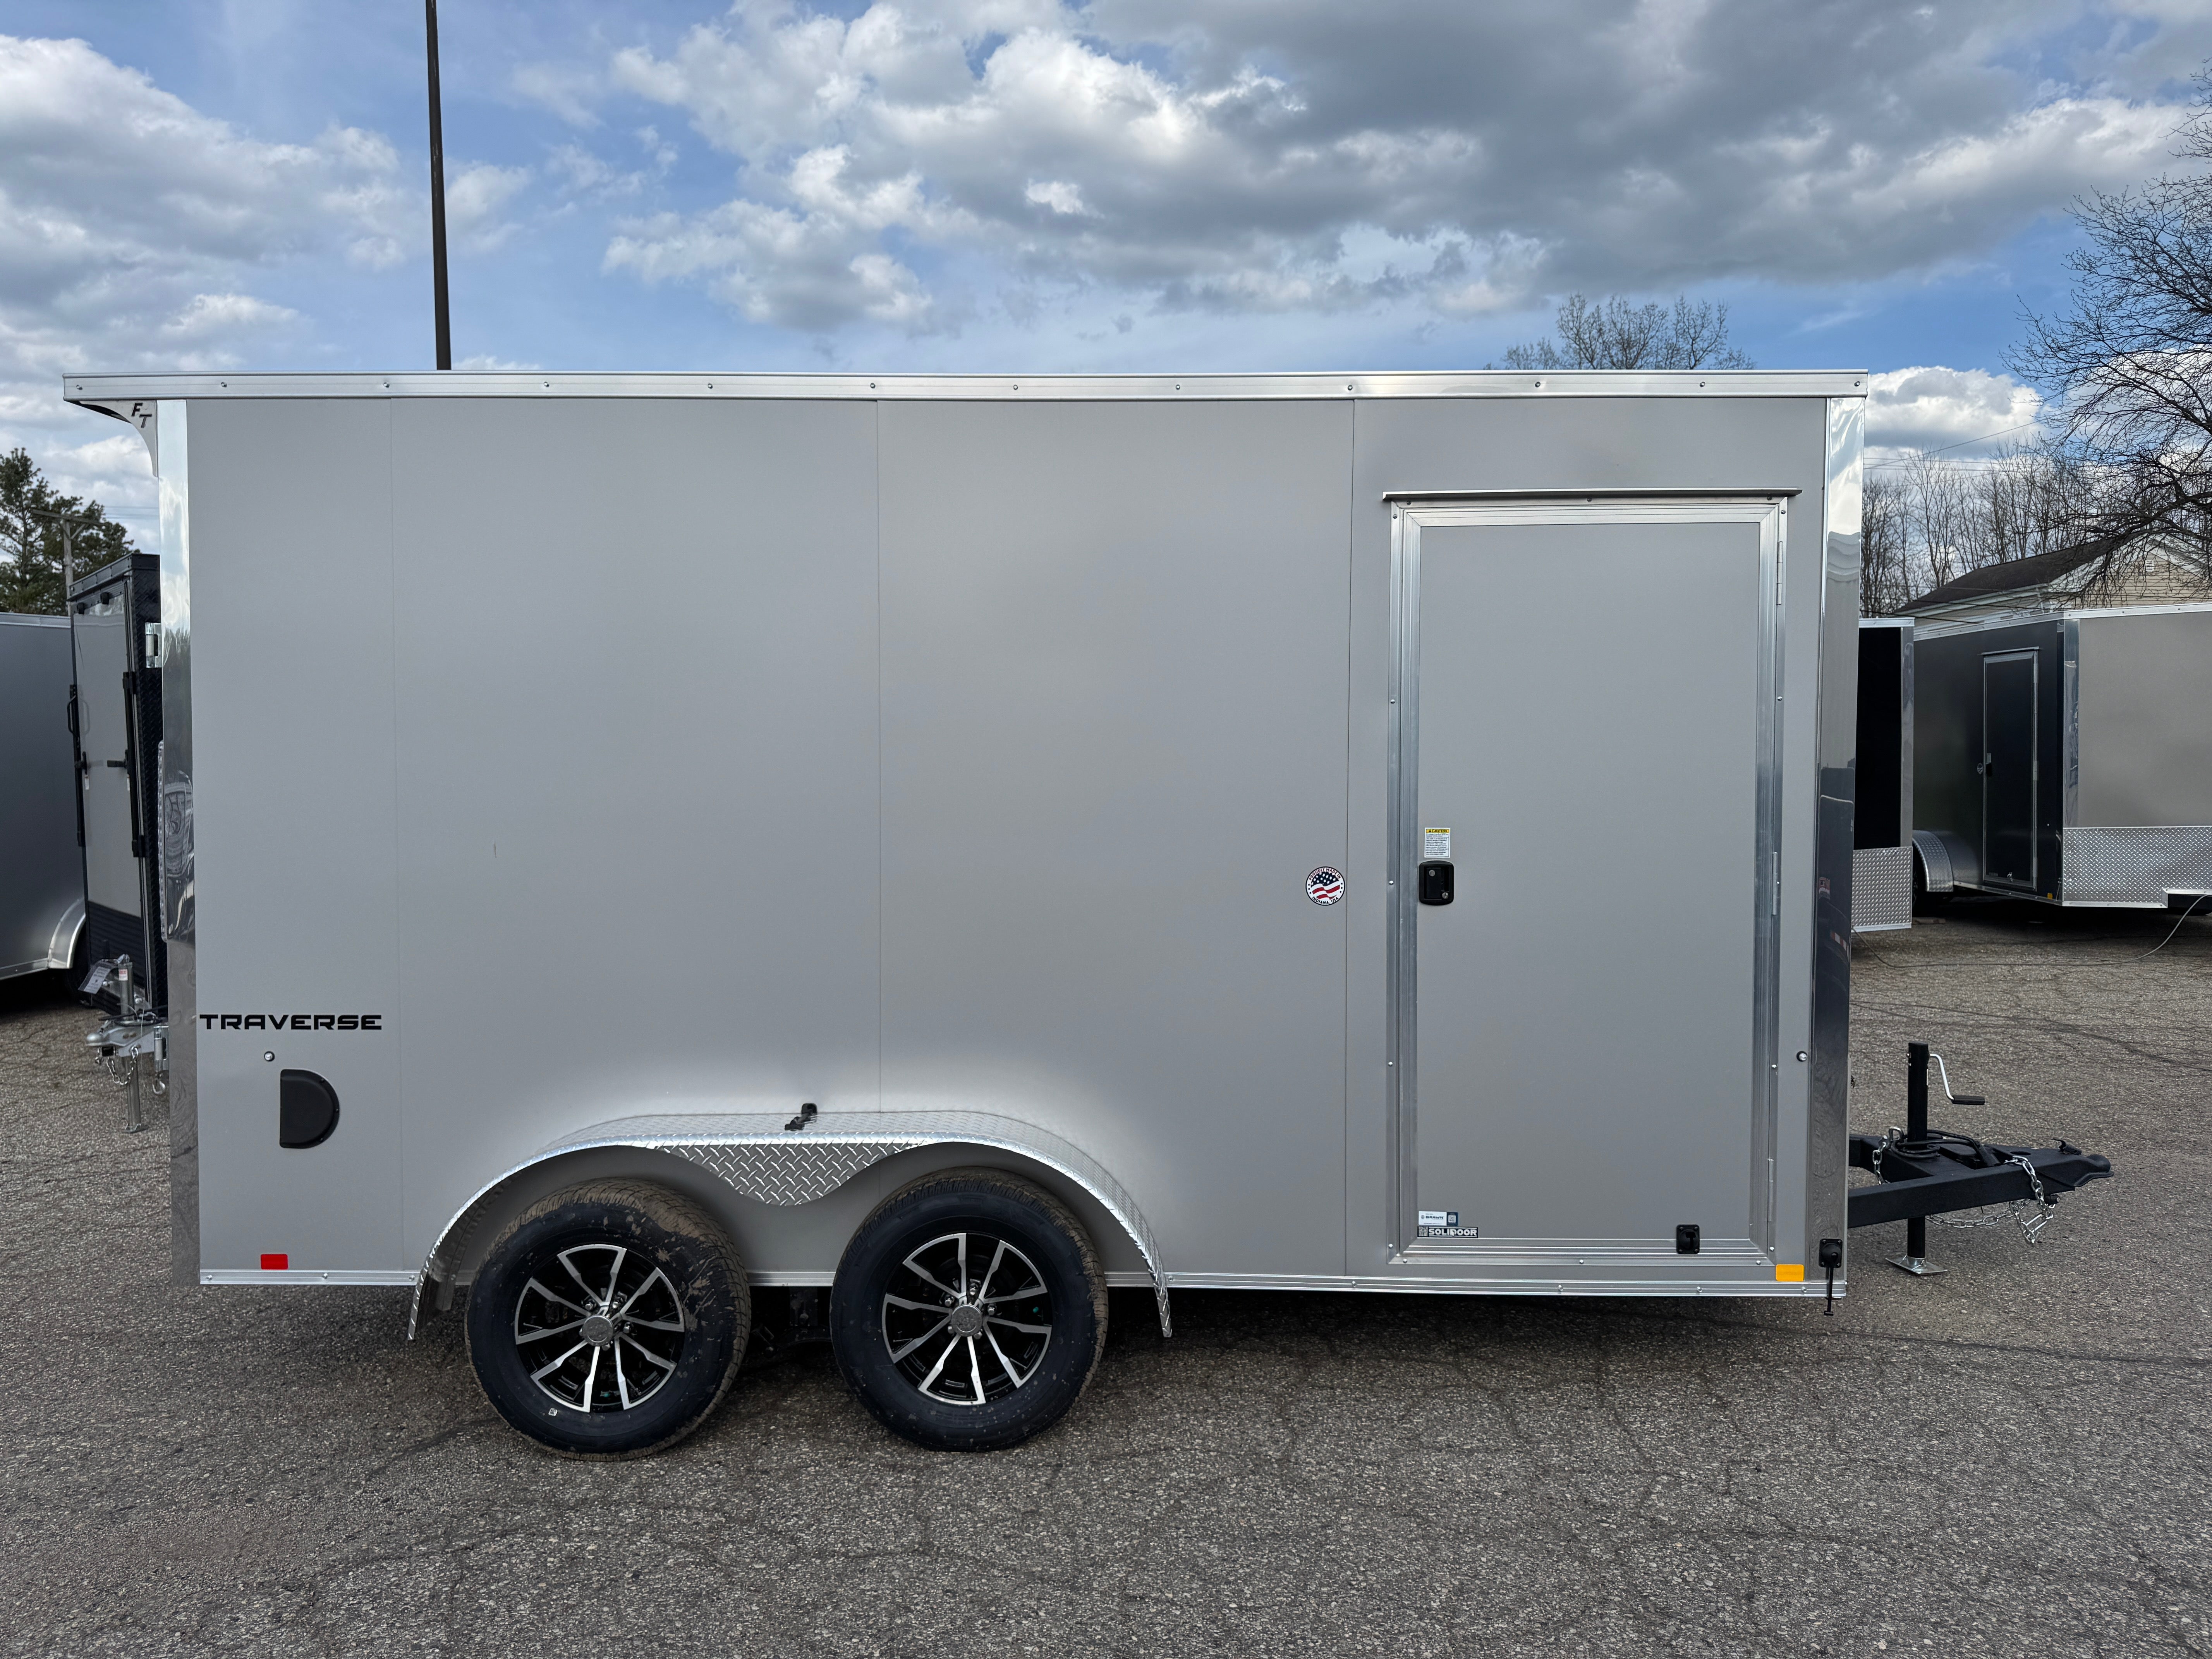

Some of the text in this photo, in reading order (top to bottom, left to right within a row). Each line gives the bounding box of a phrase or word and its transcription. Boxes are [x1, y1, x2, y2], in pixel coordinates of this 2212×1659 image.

[131, 402, 153, 428] FT
[1309, 868, 1325, 881] PROUDLY
[199, 1014, 382, 1030] TRAVERSE
[1429, 1228, 1477, 1237] SOLIDOOR
